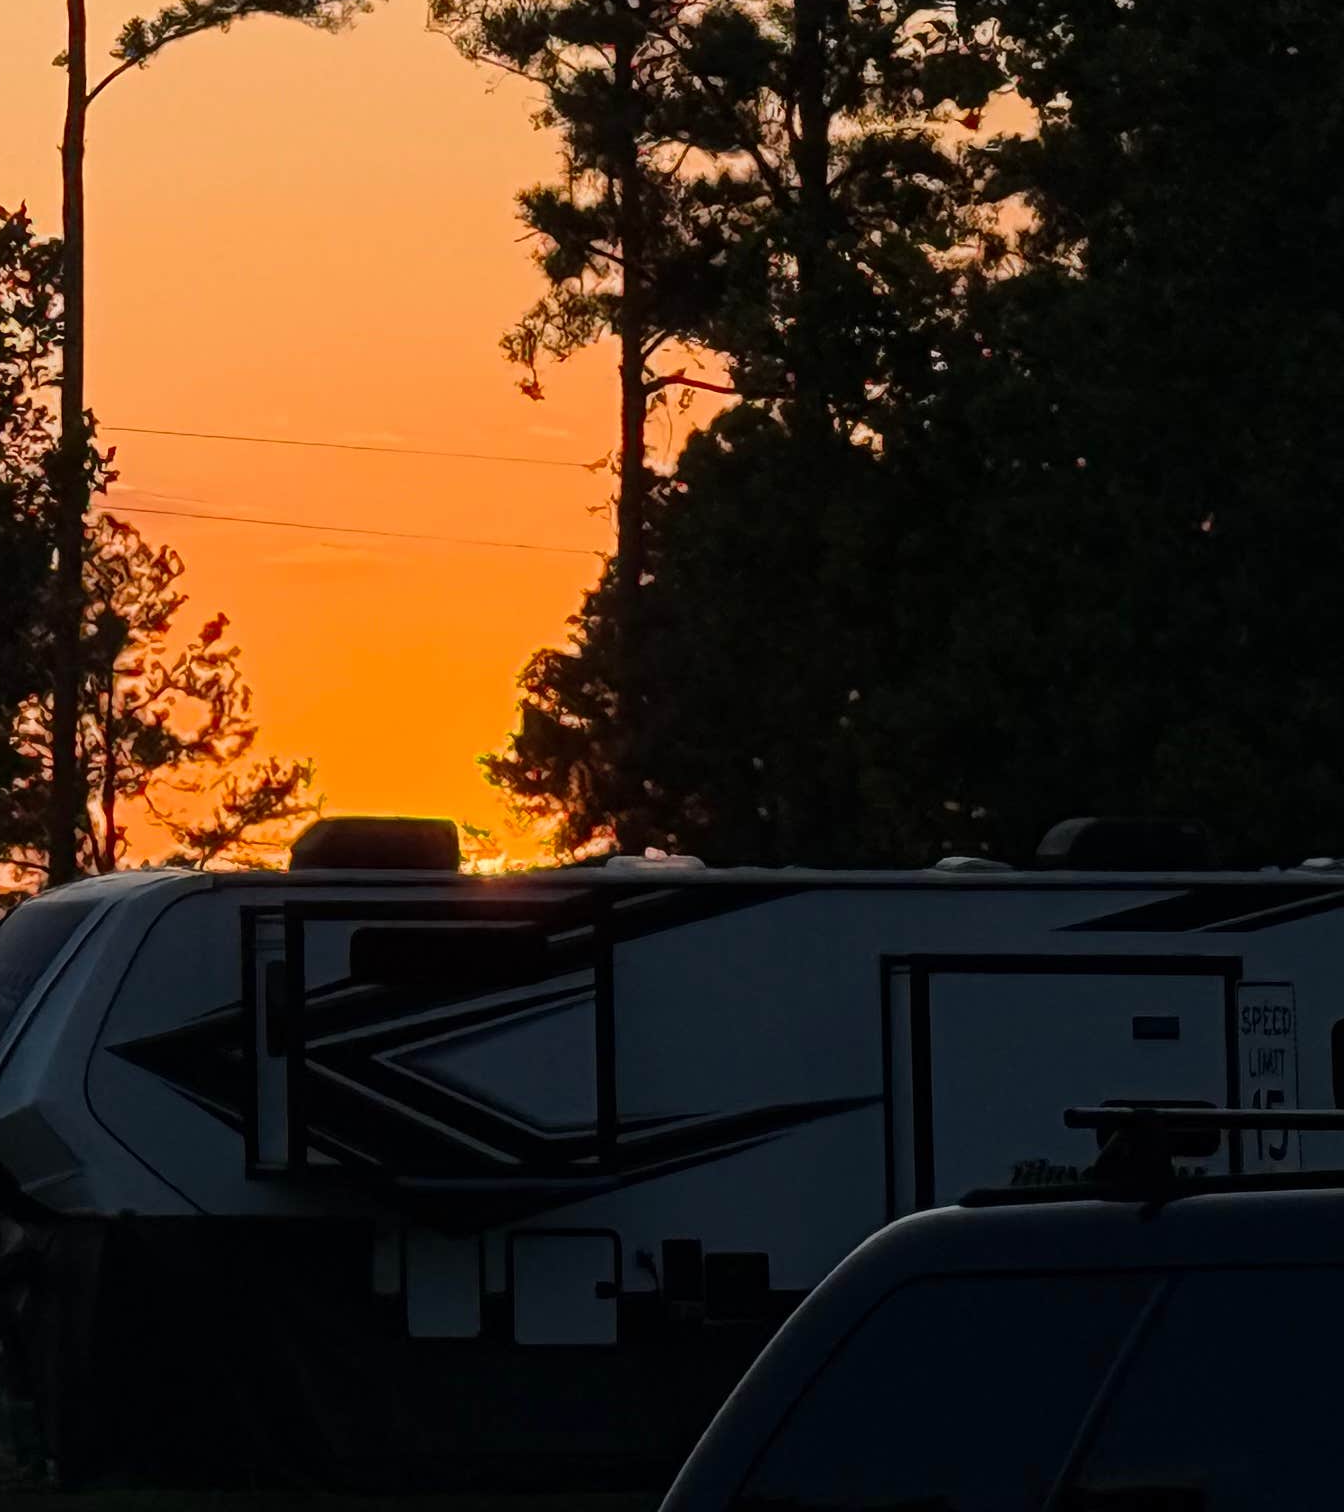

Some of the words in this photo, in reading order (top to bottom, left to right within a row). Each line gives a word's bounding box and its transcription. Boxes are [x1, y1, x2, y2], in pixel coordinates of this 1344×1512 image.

[1241, 1005, 1292, 1035] SPEED
[1248, 1048, 1285, 1079] LIMIT
[1252, 1088, 1288, 1161] 15
